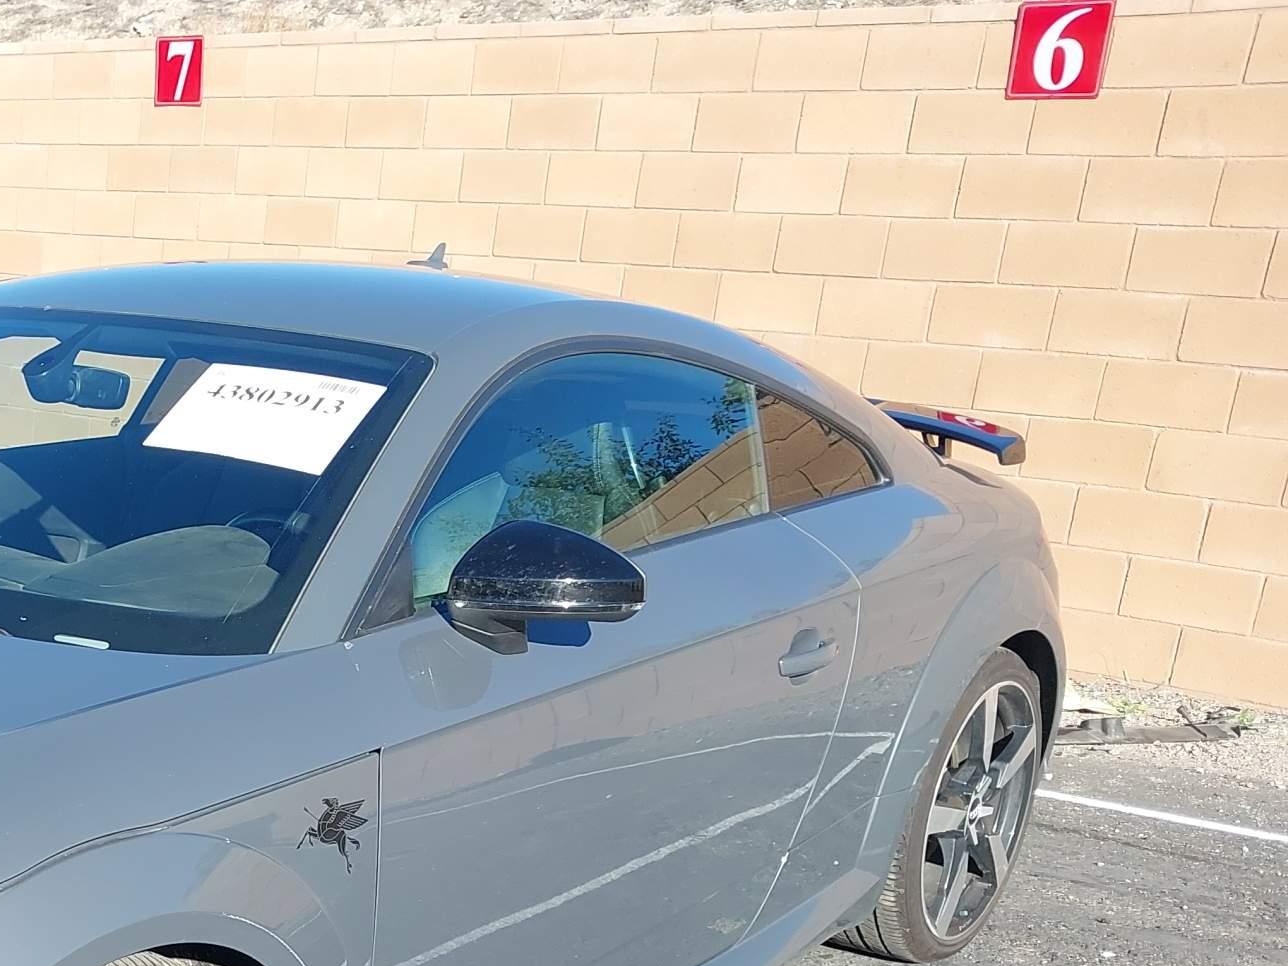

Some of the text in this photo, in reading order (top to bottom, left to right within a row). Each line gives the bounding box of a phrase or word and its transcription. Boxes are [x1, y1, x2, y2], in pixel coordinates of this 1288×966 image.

[166, 40, 195, 102] 7
[1032, 7, 1093, 91] 6
[207, 383, 345, 414] 43802913
